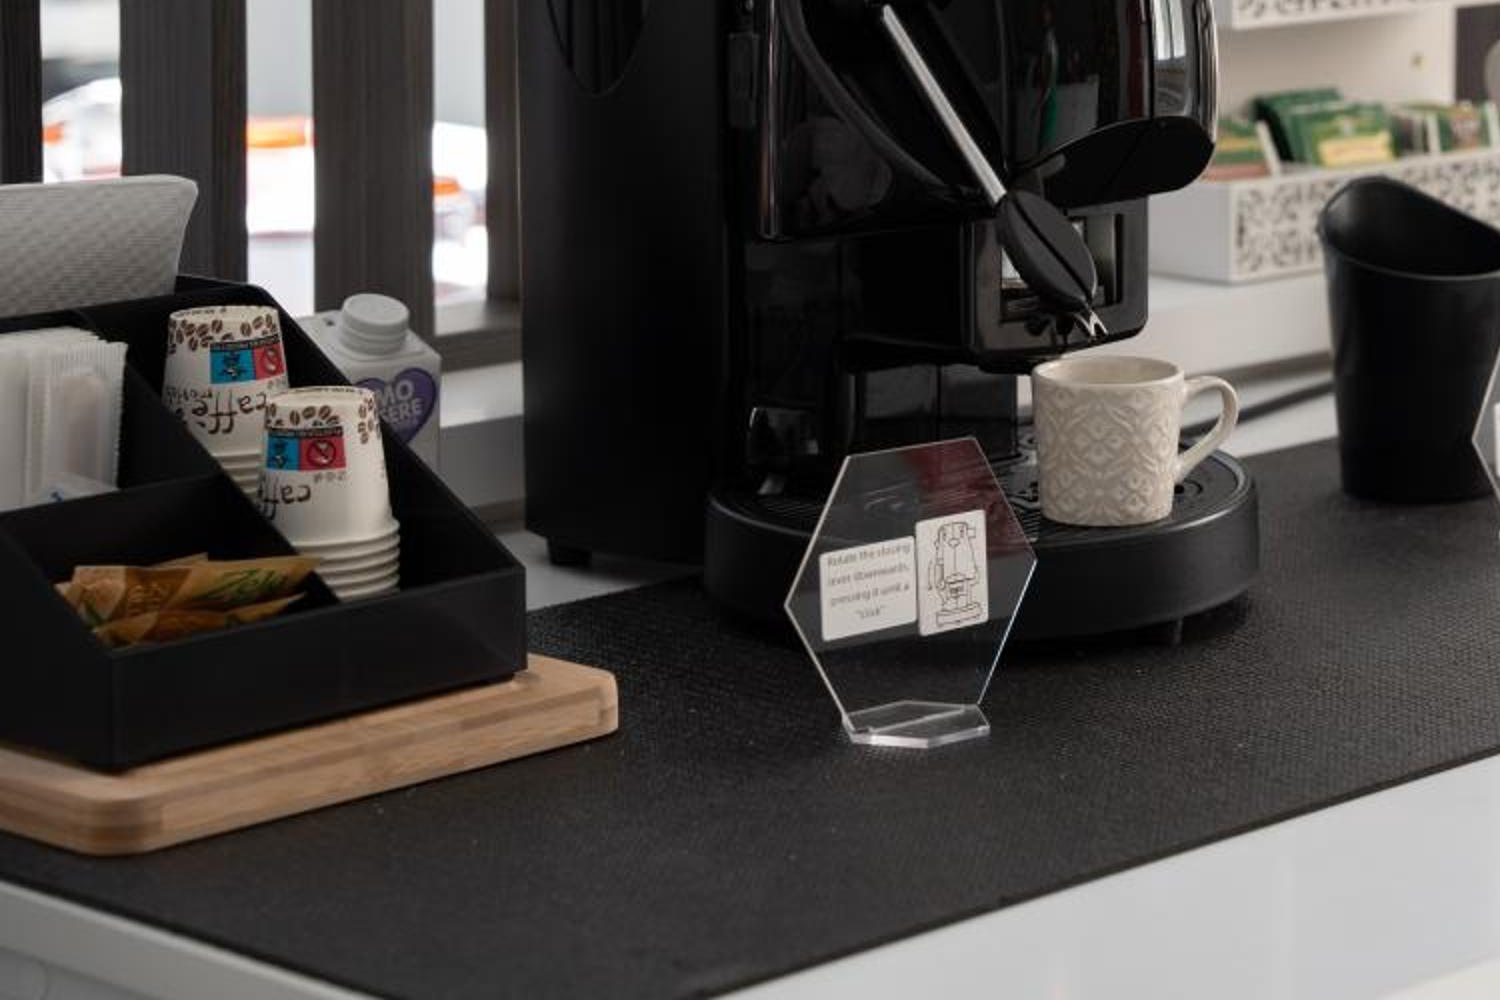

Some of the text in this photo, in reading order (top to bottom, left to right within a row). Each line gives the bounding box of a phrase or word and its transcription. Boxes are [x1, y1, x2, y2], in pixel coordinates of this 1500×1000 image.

[375, 380, 415, 406] MO
[379, 397, 423, 421] SERE
[827, 553, 857, 567] Rotate
[860, 551, 875, 560] the
